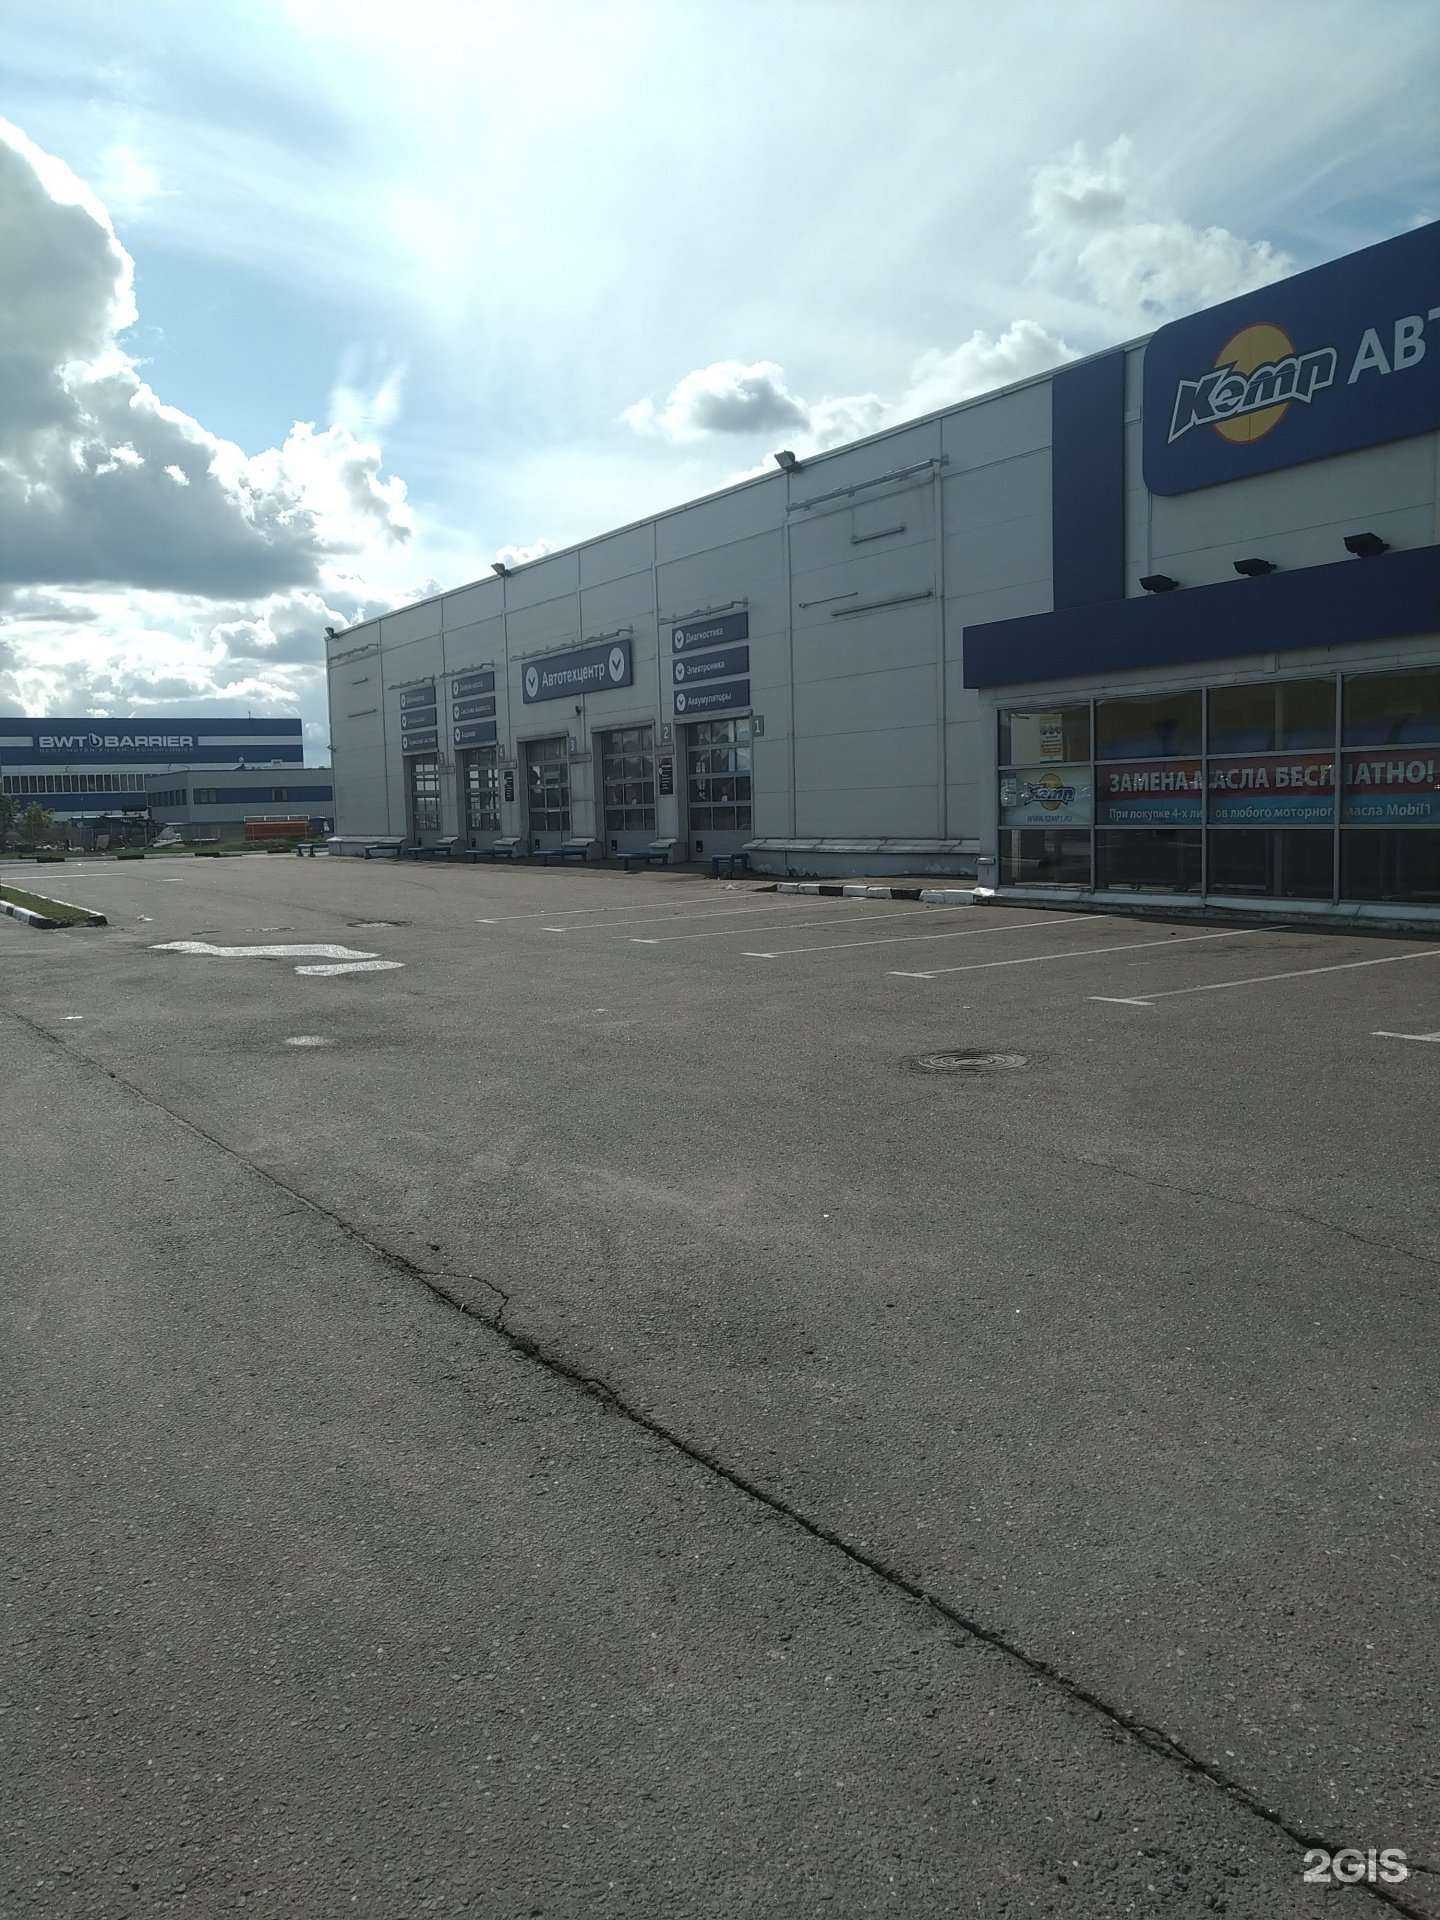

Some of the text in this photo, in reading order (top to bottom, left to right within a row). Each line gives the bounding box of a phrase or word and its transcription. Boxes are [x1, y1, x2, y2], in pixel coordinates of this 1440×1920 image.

[685, 626, 724, 644] Диагностика
[541, 662, 606, 689] Автотехцентр
[686, 660, 726, 676] Электроника
[687, 691, 732, 708] Аккумуляторы
[39, 735, 193, 749] BWT BARRIER
[1109, 771, 1188, 793] ЗАМЕНА
[1109, 808, 1129, 821] При
[1130, 809, 1170, 822] покупке
[1230, 806, 1272, 818] любого
